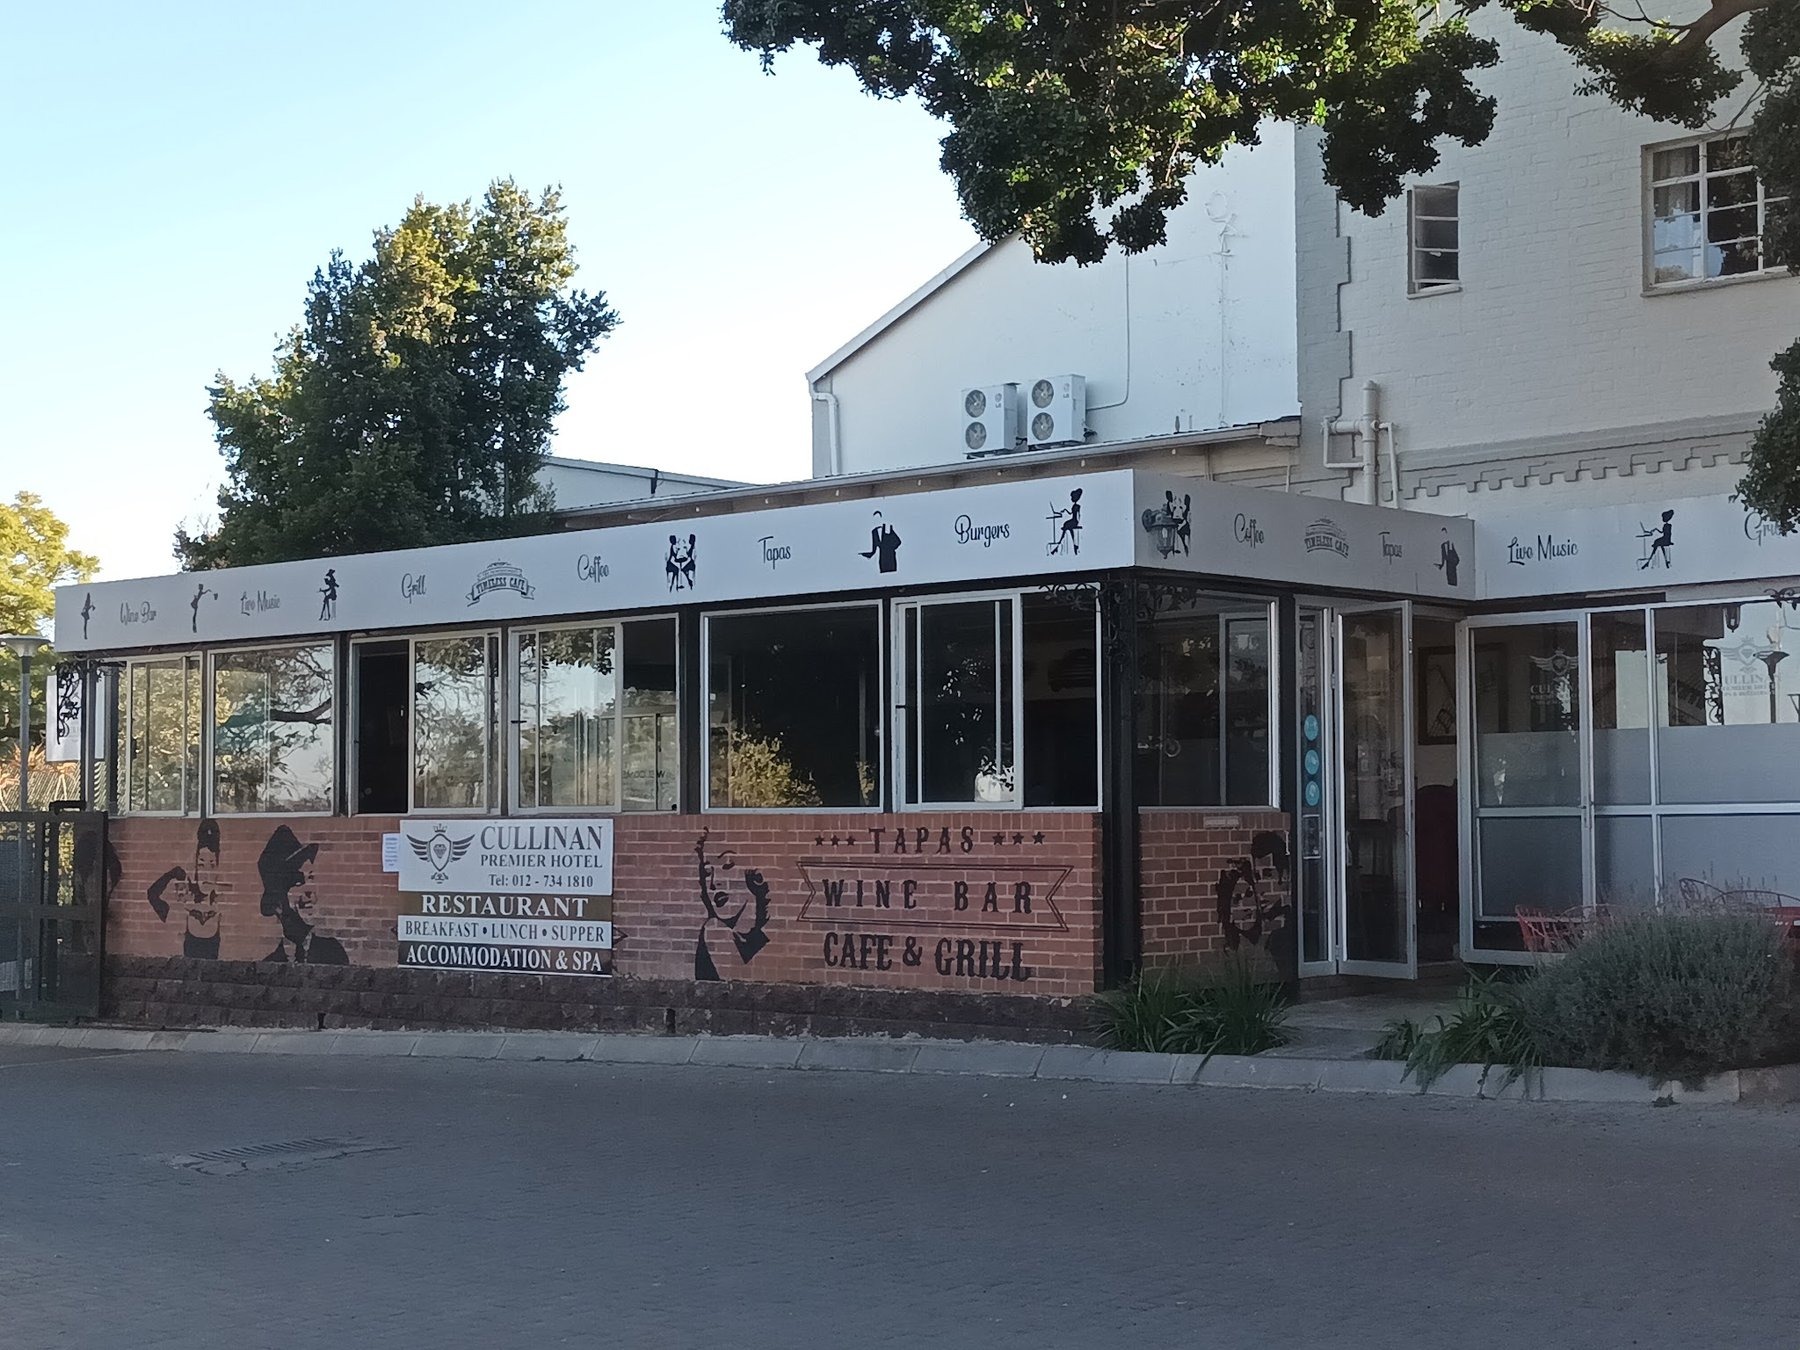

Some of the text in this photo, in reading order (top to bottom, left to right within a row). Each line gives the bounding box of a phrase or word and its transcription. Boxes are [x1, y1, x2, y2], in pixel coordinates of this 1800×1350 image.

[954, 514, 1010, 548] Burgers
[1234, 513, 1264, 549] Coffee
[1744, 511, 1781, 547] Gri
[758, 536, 791, 570] Tapas
[1378, 531, 1402, 565] Tapas
[1507, 534, 1579, 566] Live Music
[577, 554, 610, 583] Coffee
[257, 590, 281, 613] Music
[401, 573, 427, 604] Grill
[141, 601, 157, 623] Bar
[480, 825, 603, 850] CULLINAN
[868, 826, 974, 854] TAPAS
[480, 854, 603, 868] PREMIER HOTEL
[489, 873, 509, 887] Tel:
[512, 874, 531, 887] 012
[543, 874, 563, 888] 734
[566, 875, 594, 888] 1810
[421, 894, 589, 918] RESTAURANT
[822, 878, 1032, 914] WINE BAR
[405, 920, 605, 942] BREAKFAST LUNCH SUPPER
[406, 944, 602, 972] ACCOMMODATION & SPA
[823, 931, 1032, 982] CAFE & GRILL
